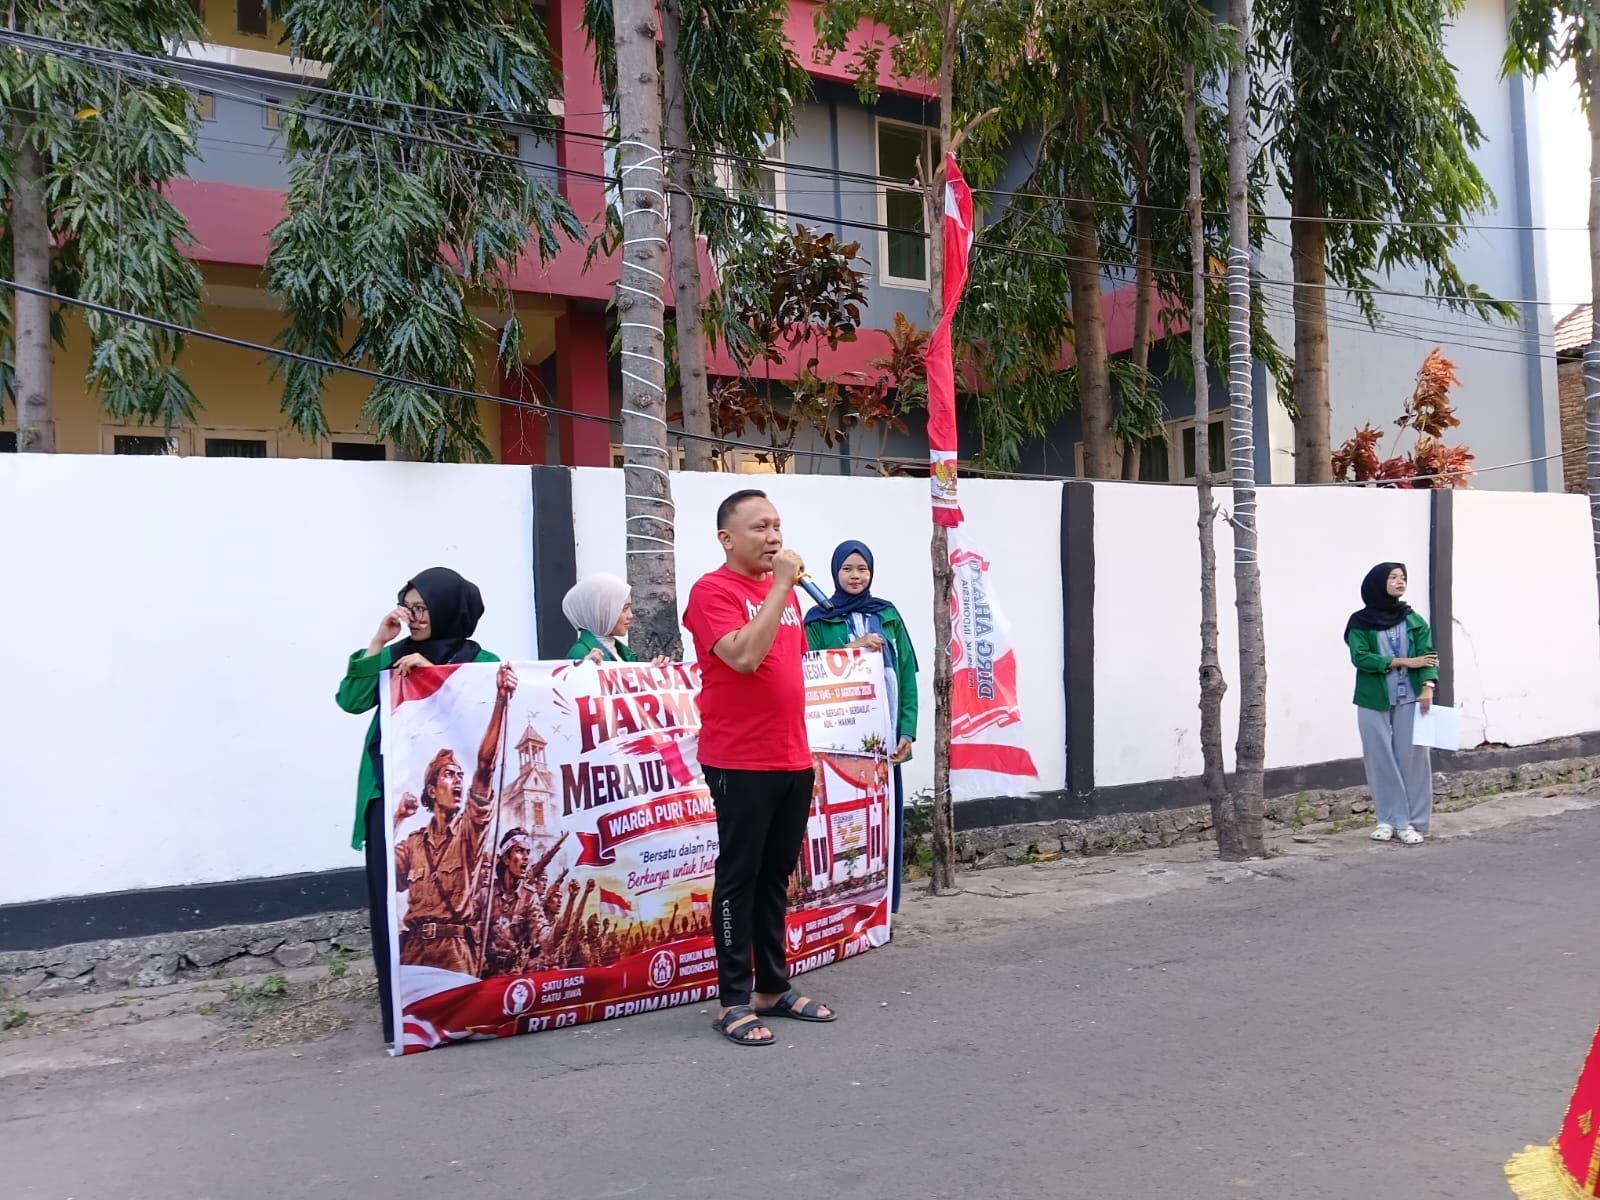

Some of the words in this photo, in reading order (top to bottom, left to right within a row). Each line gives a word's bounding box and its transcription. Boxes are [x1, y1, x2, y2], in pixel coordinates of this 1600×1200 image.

[608, 807, 654, 838] WARGA
[654, 801, 683, 823] PURI
[679, 843, 704, 857] dalam
[627, 867, 670, 889] Berkarya
[673, 858, 697, 878] untuk
[722, 899, 733, 947] adidas
[680, 961, 715, 976] INDONESIA
[542, 980, 562, 992] SATU
[563, 976, 584, 988] RASA
[541, 992, 561, 1003] SATU
[562, 989, 582, 1000] JIWA
[528, 1016, 551, 1032] RT
[555, 1012, 577, 1027] 03
